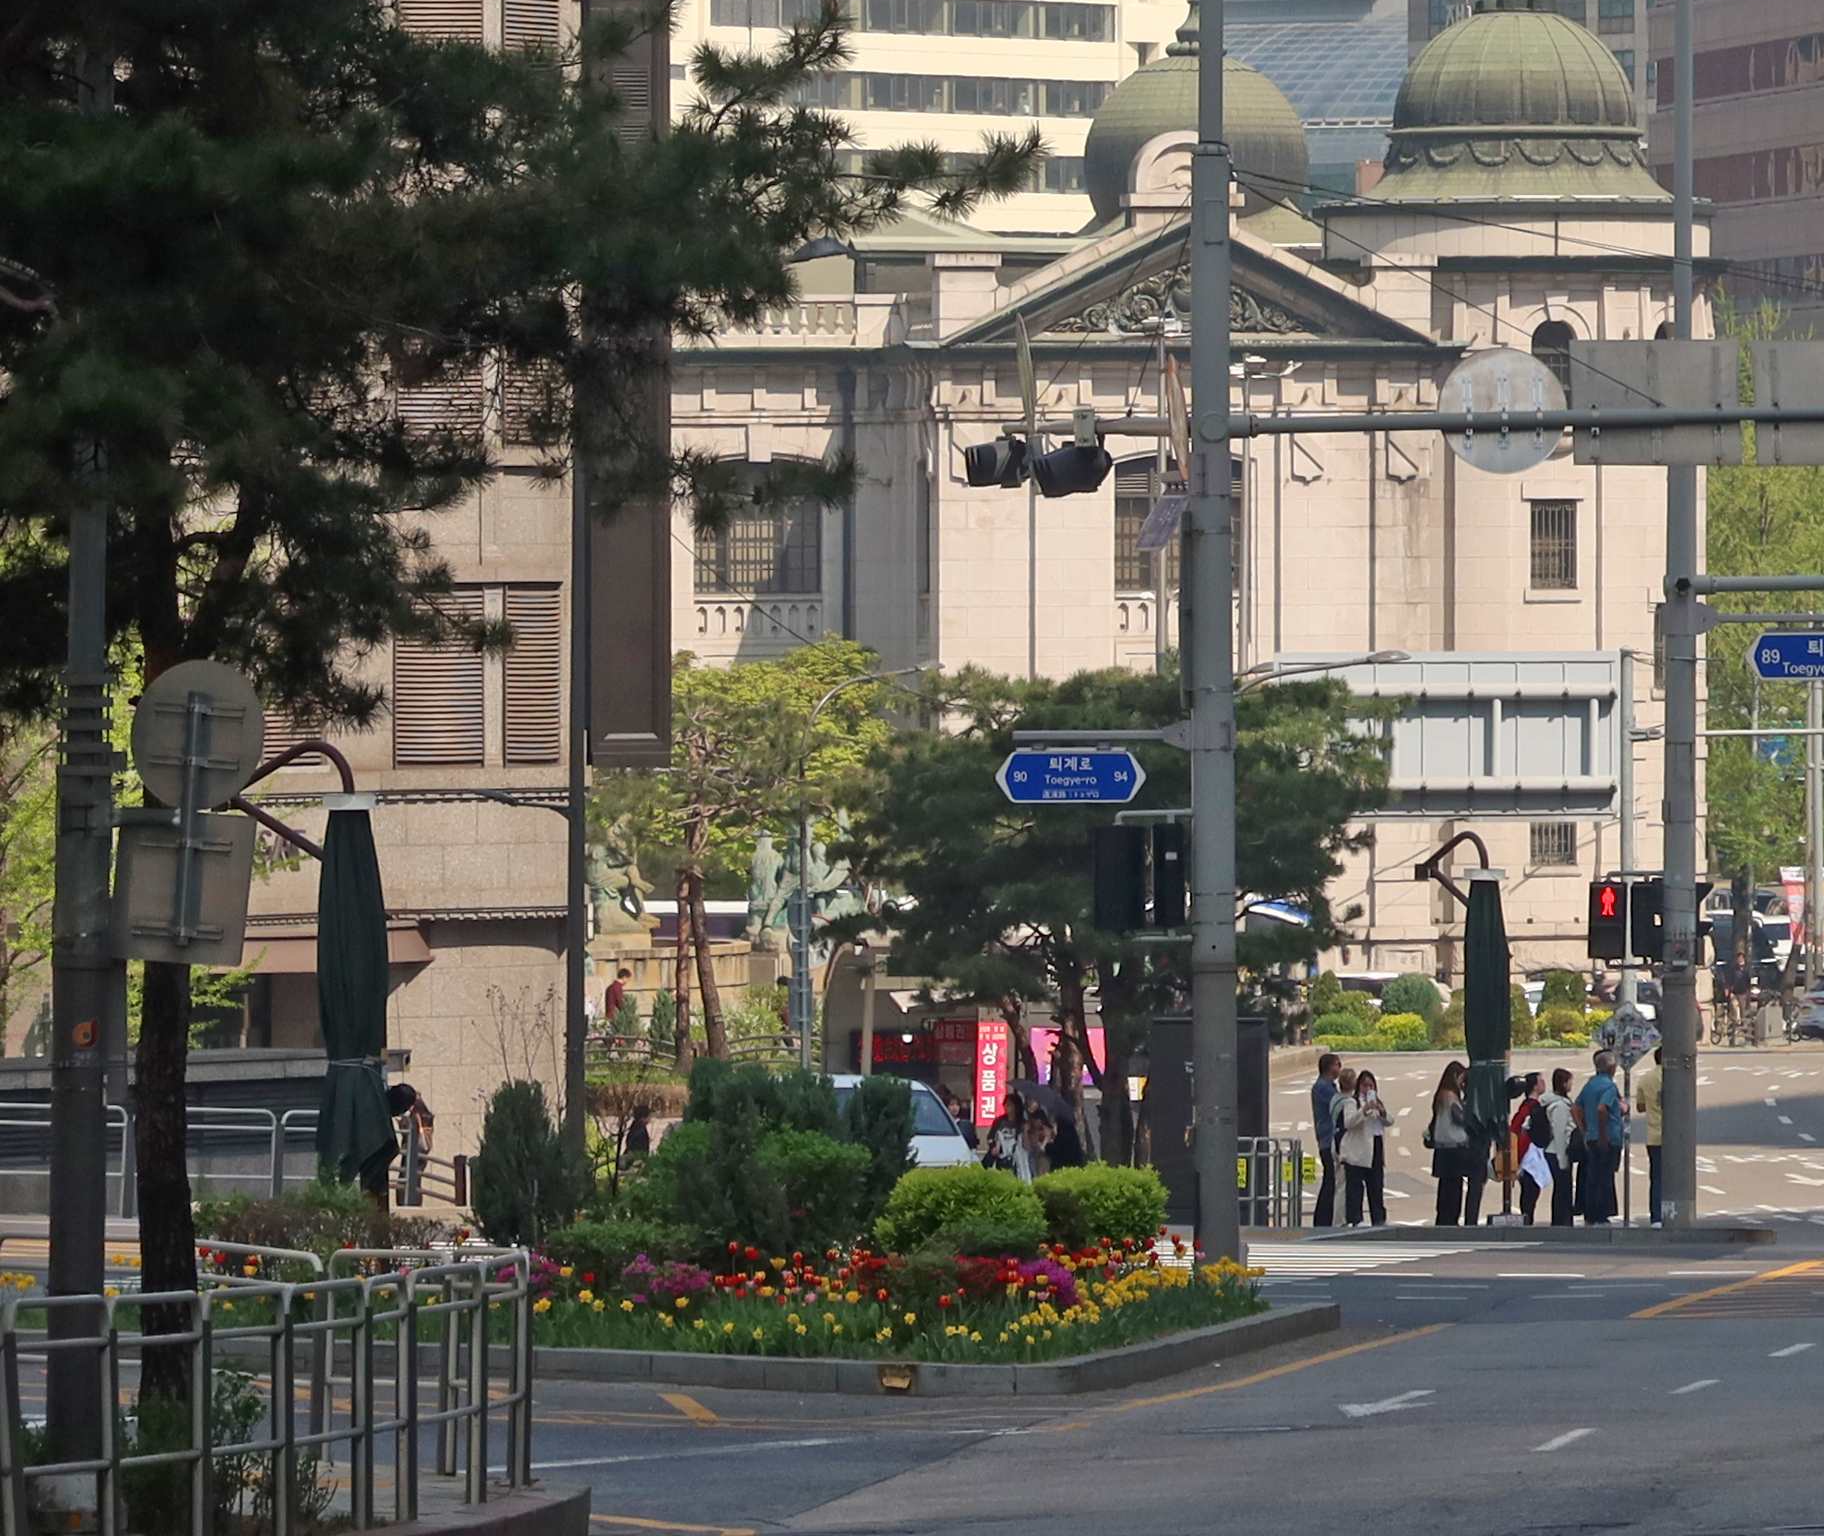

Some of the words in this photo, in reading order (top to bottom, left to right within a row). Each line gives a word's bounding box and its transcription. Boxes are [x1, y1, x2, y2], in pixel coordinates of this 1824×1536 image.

[1761, 649, 1781, 664] 89
[1049, 756, 1094, 772] 퇴계로
[1013, 770, 1028, 783] 90
[1044, 774, 1098, 786] Toegye-ro
[1113, 770, 1129, 783] 94
[980, 1042, 998, 1120] 상품권
